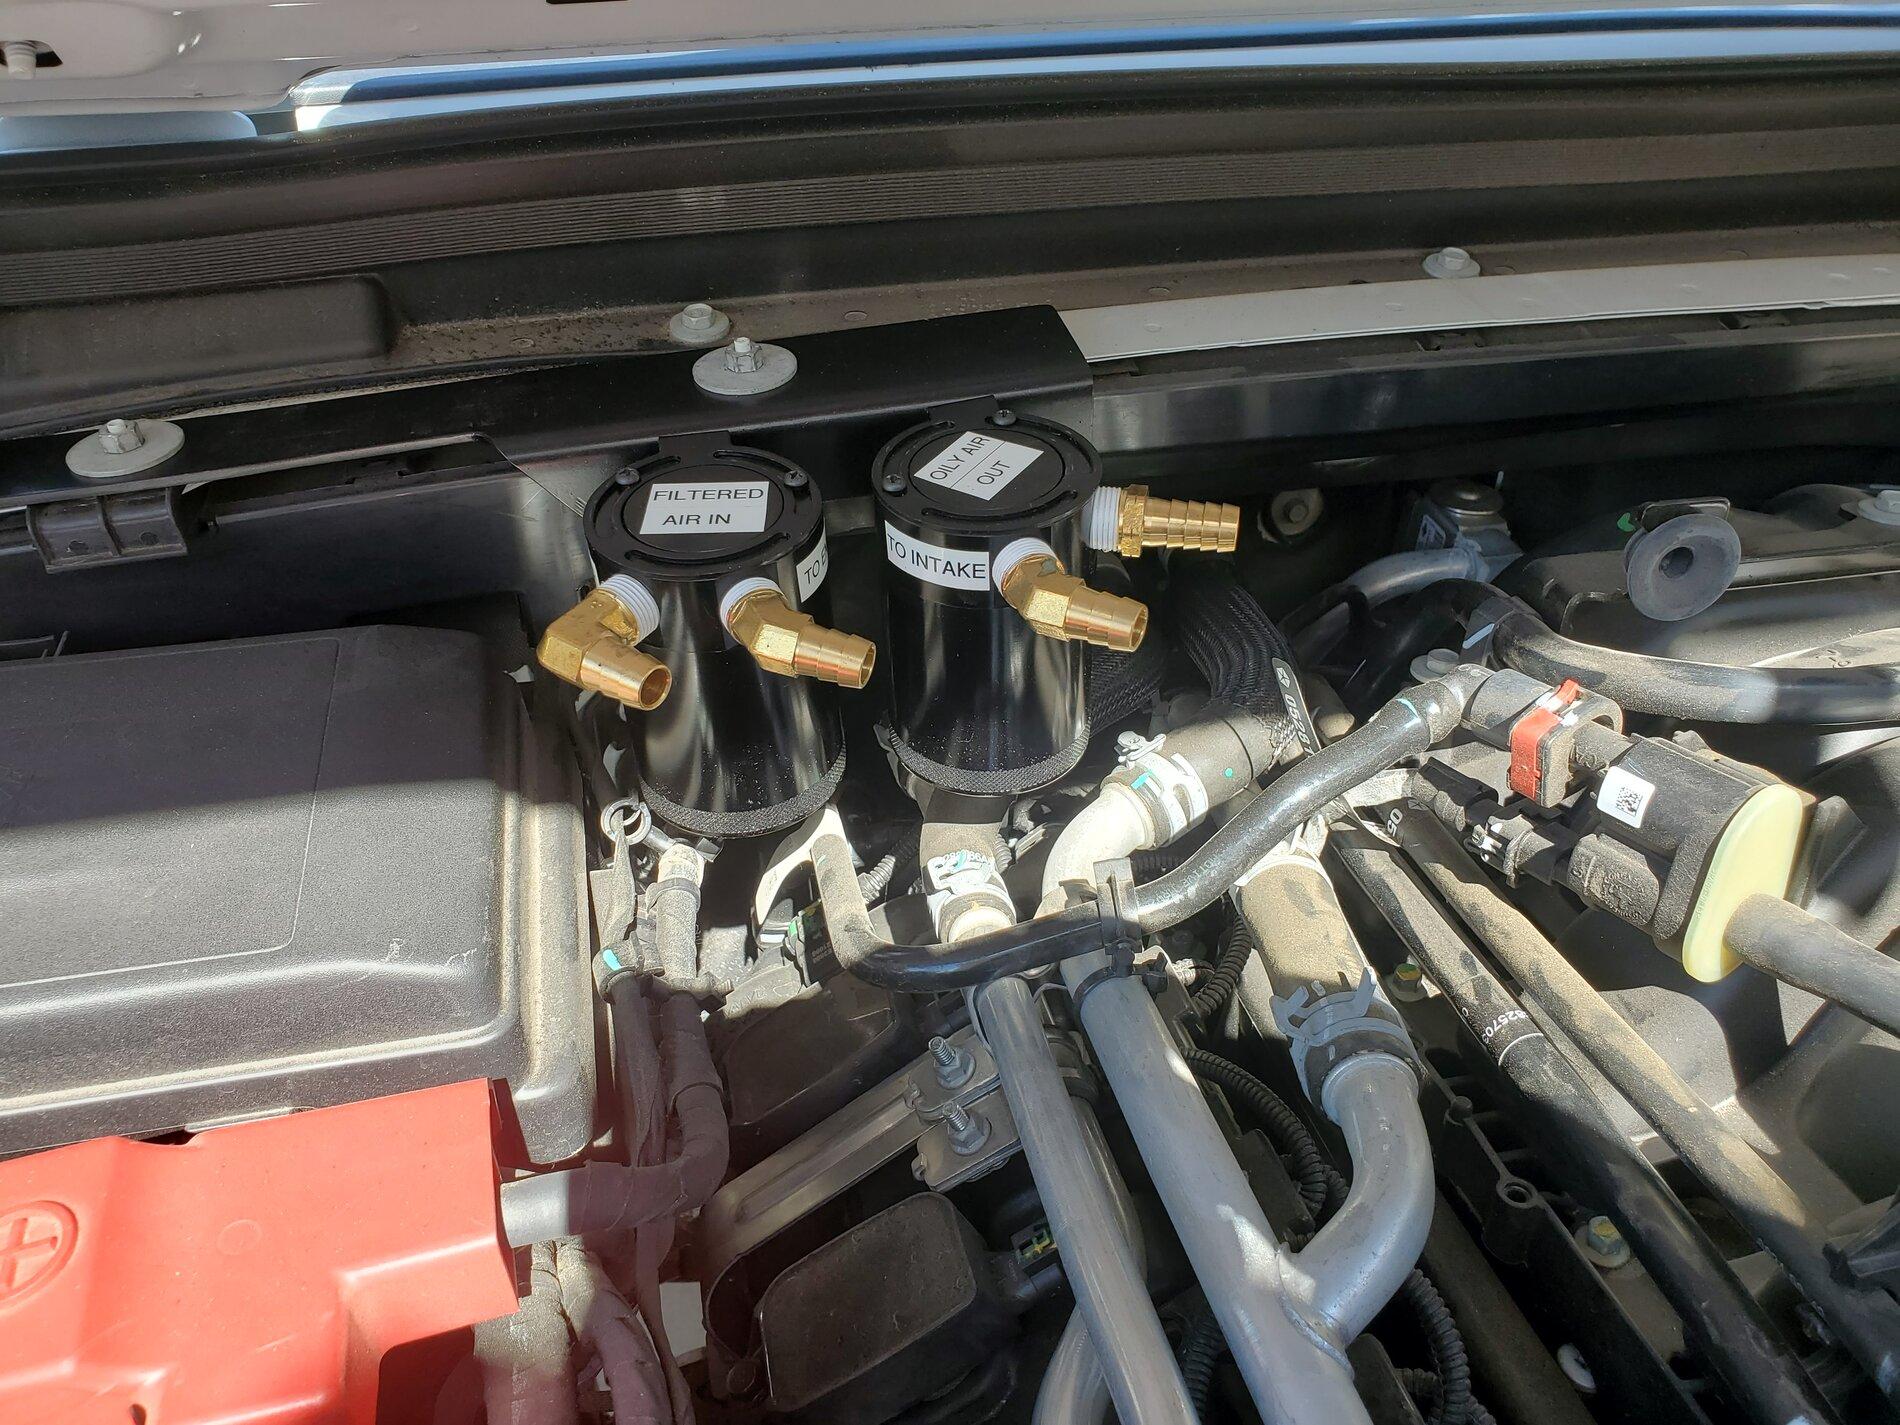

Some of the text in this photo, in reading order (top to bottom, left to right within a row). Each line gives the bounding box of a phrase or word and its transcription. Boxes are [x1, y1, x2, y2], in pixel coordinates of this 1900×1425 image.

[930, 436, 990, 480] OILY AIR
[976, 460, 1011, 485] OUT
[653, 488, 765, 501] FILTERED
[662, 513, 731, 526] AIR IN
[887, 533, 986, 579] TO INTAKE
[803, 559, 820, 585] TO
